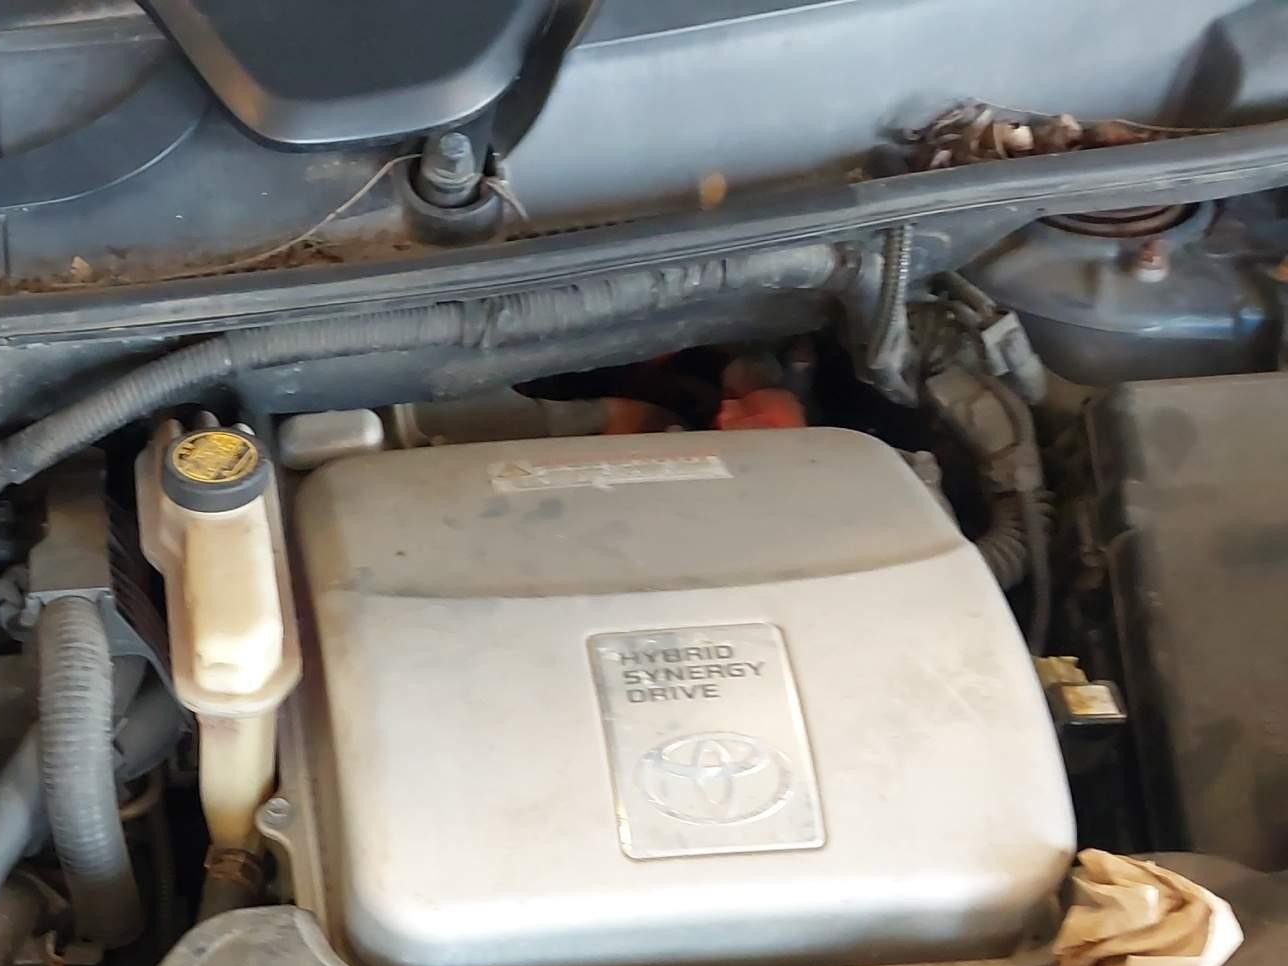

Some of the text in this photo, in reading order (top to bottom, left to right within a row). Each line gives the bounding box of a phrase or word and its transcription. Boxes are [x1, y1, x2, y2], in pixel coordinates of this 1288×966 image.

[620, 645, 733, 664] HYBRID
[623, 662, 765, 685] SYNERGY
[627, 683, 721, 704] DRIVE
